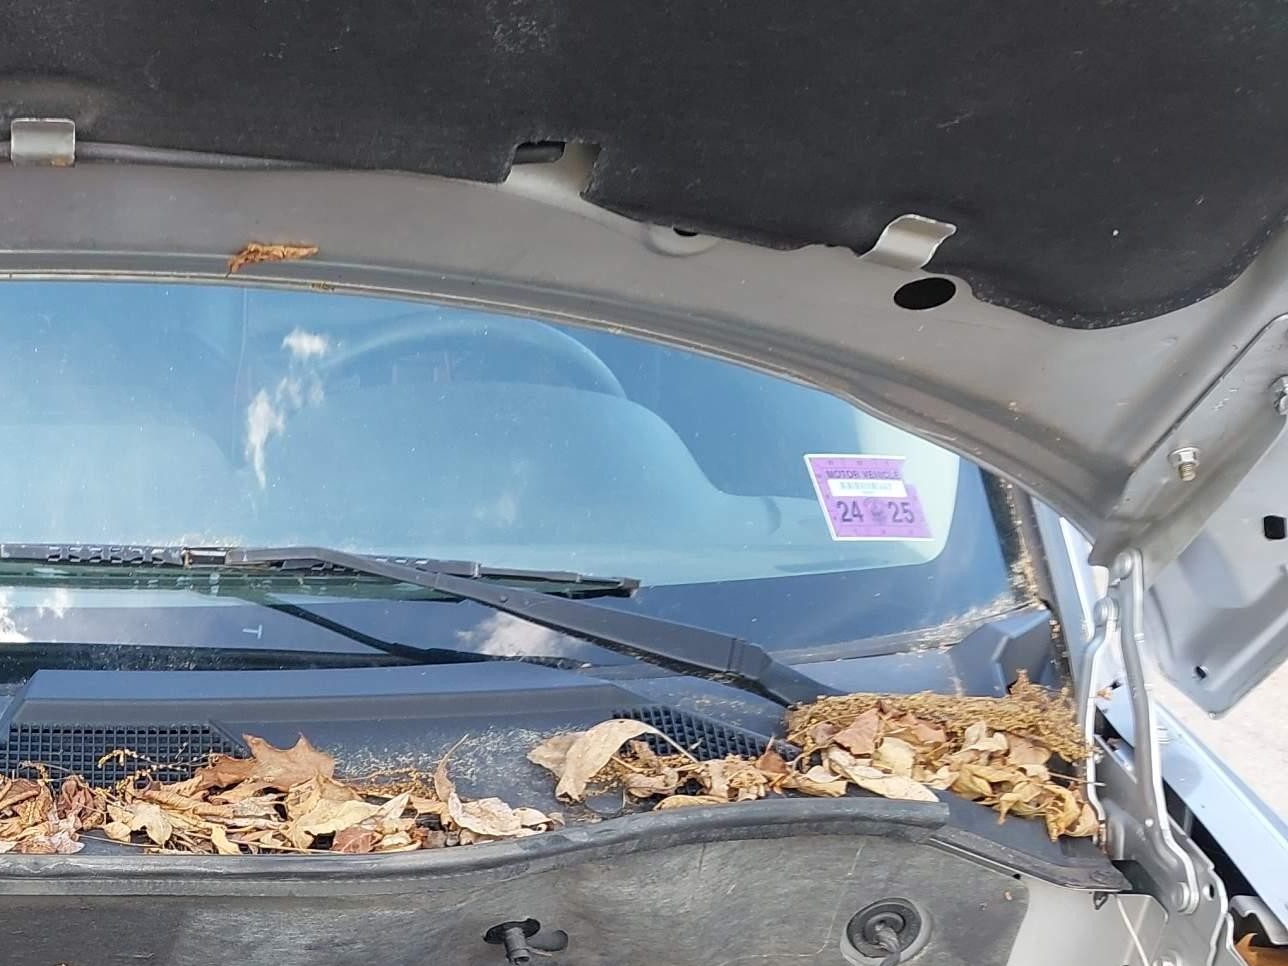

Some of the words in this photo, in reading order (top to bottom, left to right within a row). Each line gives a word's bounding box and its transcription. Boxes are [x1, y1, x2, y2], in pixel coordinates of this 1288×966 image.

[825, 470, 859, 479] MOTOR
[836, 500, 864, 522] 24
[888, 501, 915, 523] 25
